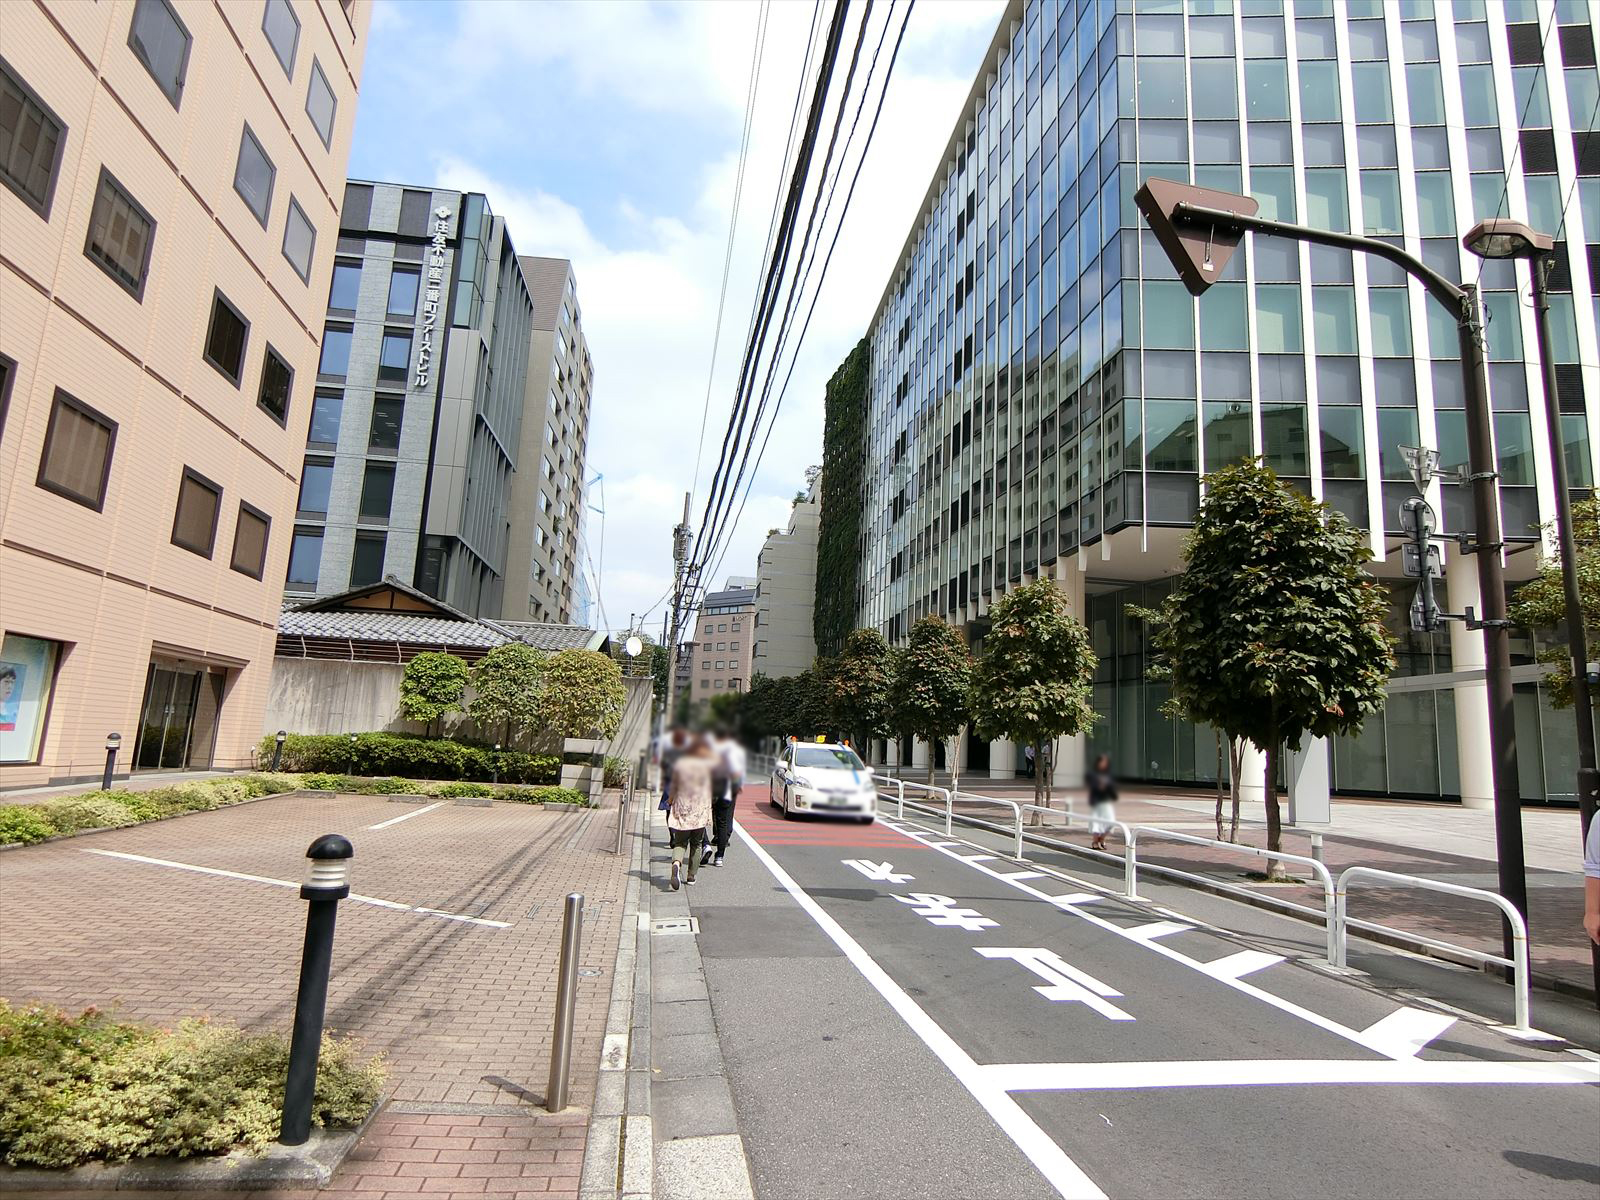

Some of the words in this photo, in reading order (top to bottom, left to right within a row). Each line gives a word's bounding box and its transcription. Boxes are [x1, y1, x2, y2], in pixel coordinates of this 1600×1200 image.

[414, 220, 448, 386] 住友不動産二番町ファーストビル
[841, 860, 1136, 1021] 止まれ
